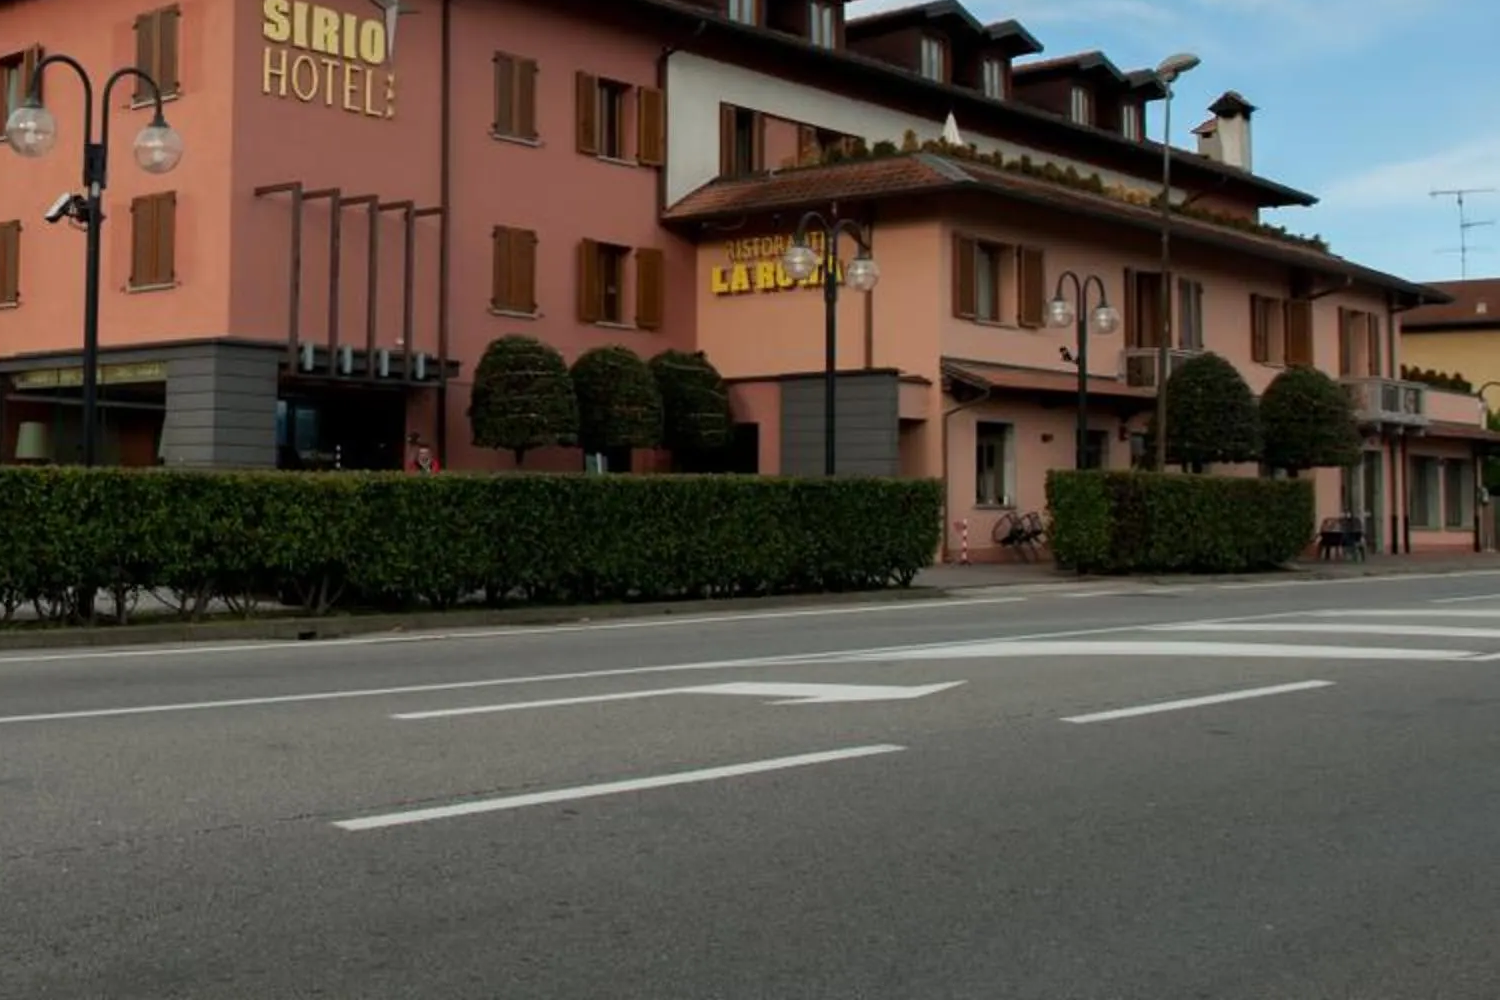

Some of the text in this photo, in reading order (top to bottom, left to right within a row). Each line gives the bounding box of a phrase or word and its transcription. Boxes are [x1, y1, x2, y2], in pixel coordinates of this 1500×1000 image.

[263, 47, 383, 116] HOTEL
[725, 231, 832, 262] RISTORAT
[711, 263, 750, 293] LA
